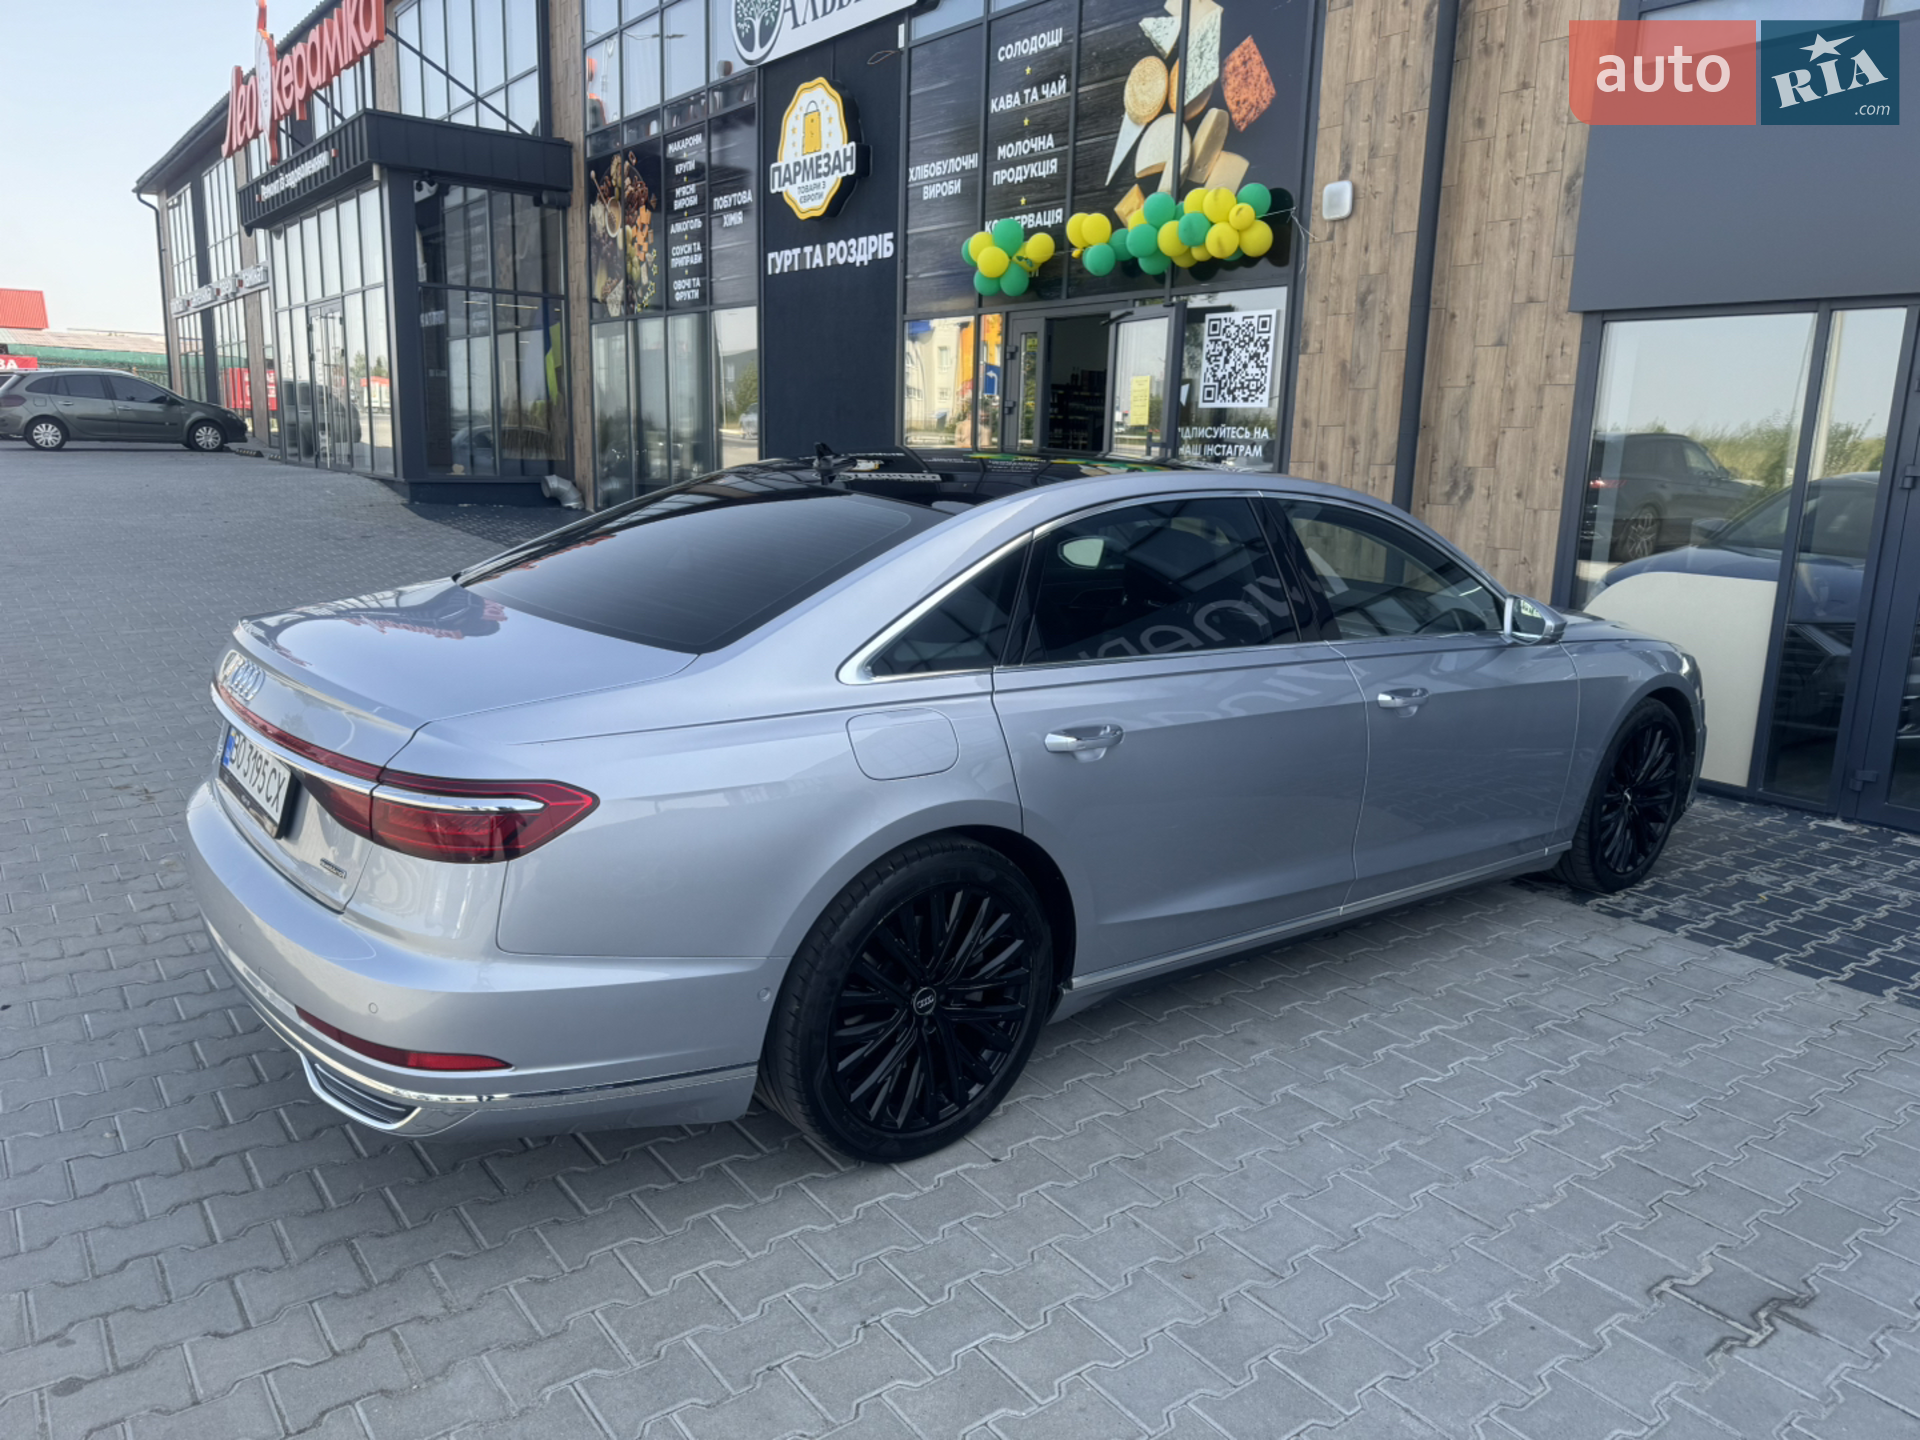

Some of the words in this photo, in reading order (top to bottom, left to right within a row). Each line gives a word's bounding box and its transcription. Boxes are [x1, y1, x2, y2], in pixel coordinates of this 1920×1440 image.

[997, 27, 1063, 62] СОЛОДОЩІ
[990, 91, 1021, 114] КАВА
[1023, 86, 1039, 105] ТА
[1041, 74, 1067, 99] ЧАЙ
[668, 133, 702, 154] МАКАРОНИ
[997, 133, 1055, 161] МОЛОЧНА
[675, 160, 696, 175] КРУПИ
[771, 144, 855, 190] ПАРМЕЗАН
[908, 153, 978, 182] ХЛІБОБУЛОЧНІ
[992, 158, 1058, 186] ПРОДУКЦІЯ
[713, 189, 752, 210] ПОБУТОВА
[922, 179, 961, 200] ВИРОБИ
[673, 195, 698, 211] ВИРОБИ
[670, 218, 703, 234] АЛКОГОЛЬ
[723, 211, 743, 227] ХІМІЯ
[985, 208, 1063, 233] КРВАЦІЯ
[672, 244, 691, 256] СОУСИ
[692, 241, 702, 253] ТА
[767, 247, 801, 275] ГУРТ
[803, 244, 824, 270] ТА
[826, 232, 894, 267] РОЗДРІБ
[671, 253, 703, 269] ПРИПРАВИ
[673, 280, 691, 291] ОВОЧІ
[692, 277, 701, 289] ТА
[675, 289, 699, 302] ФРУКТИ
[1178, 424, 1251, 440] ІДПИСУЙТЕСЬ
[1253, 427, 1269, 439] НА
[1204, 444, 1262, 456] ІНСТАГРАМ
[243, 743, 269, 794] 3195
[265, 767, 286, 813] CX
